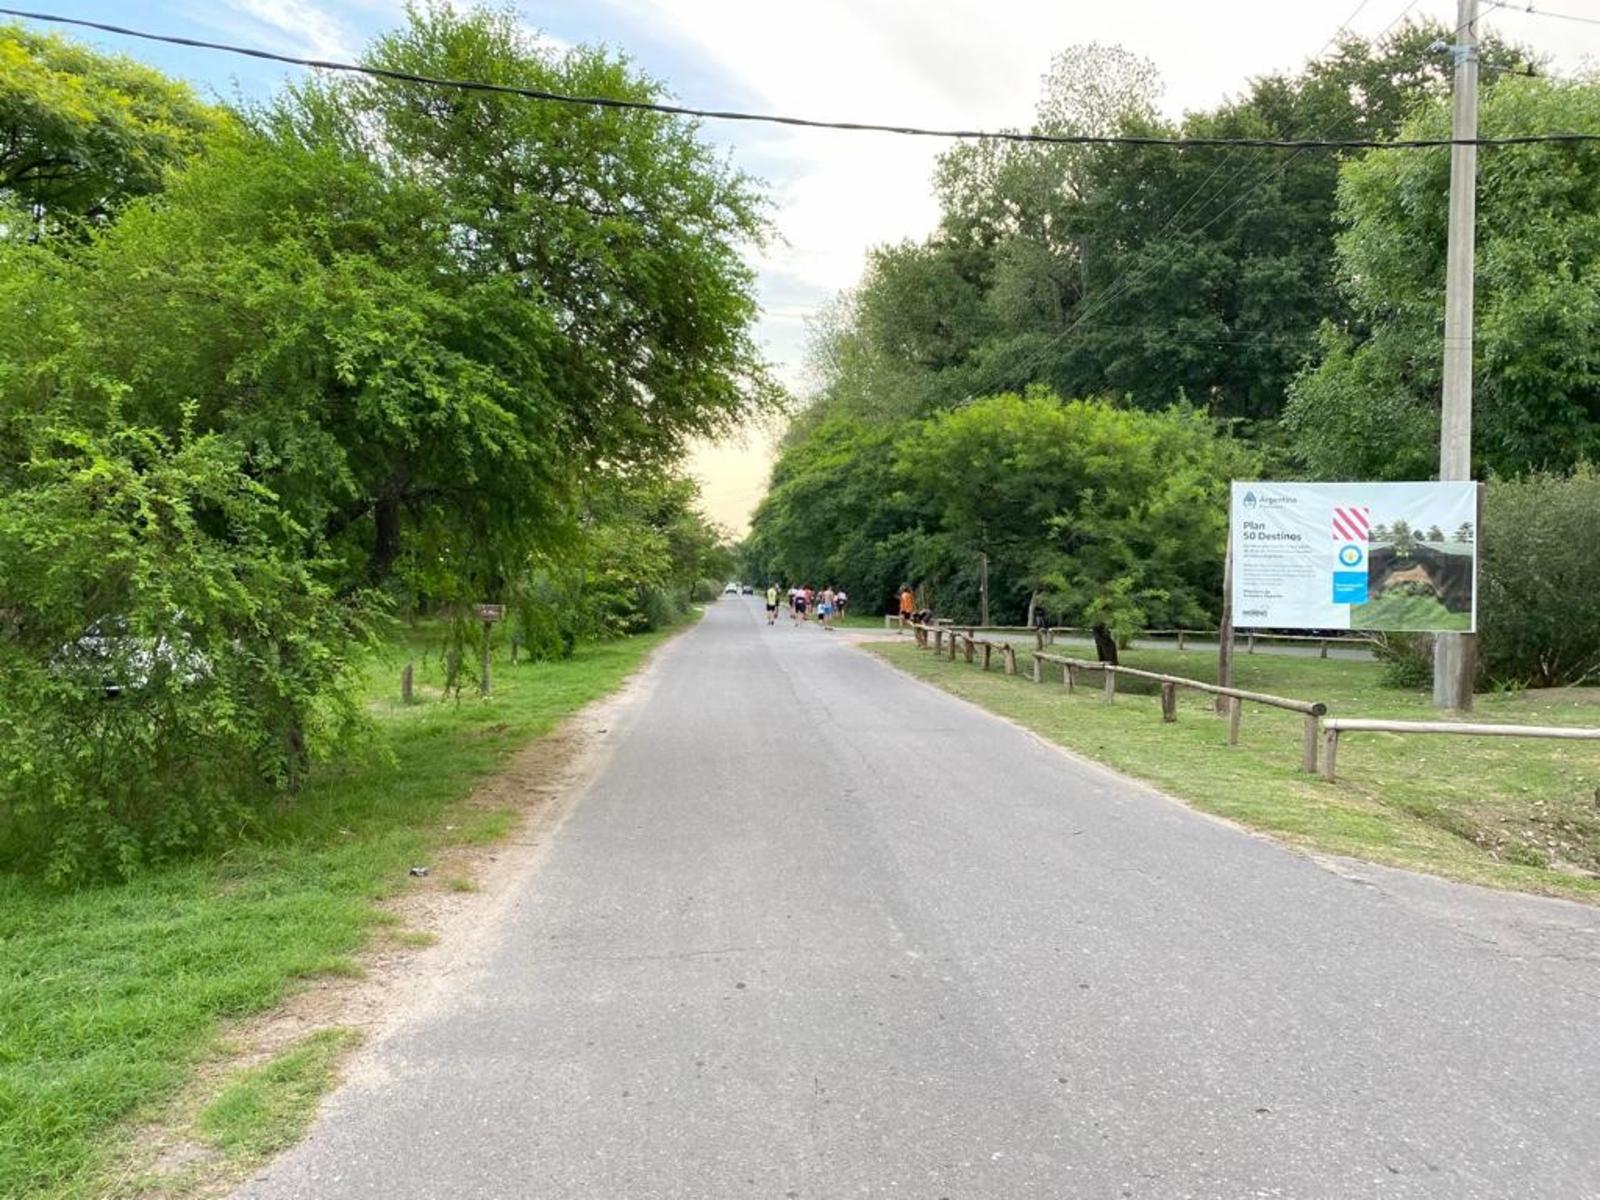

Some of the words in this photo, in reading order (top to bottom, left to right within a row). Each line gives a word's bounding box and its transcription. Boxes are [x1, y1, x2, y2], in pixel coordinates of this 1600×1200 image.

[1259, 496, 1298, 505] Argentina
[1243, 521, 1265, 530] Plan
[1243, 531, 1256, 541] 50
[1258, 531, 1302, 541] Destinos
